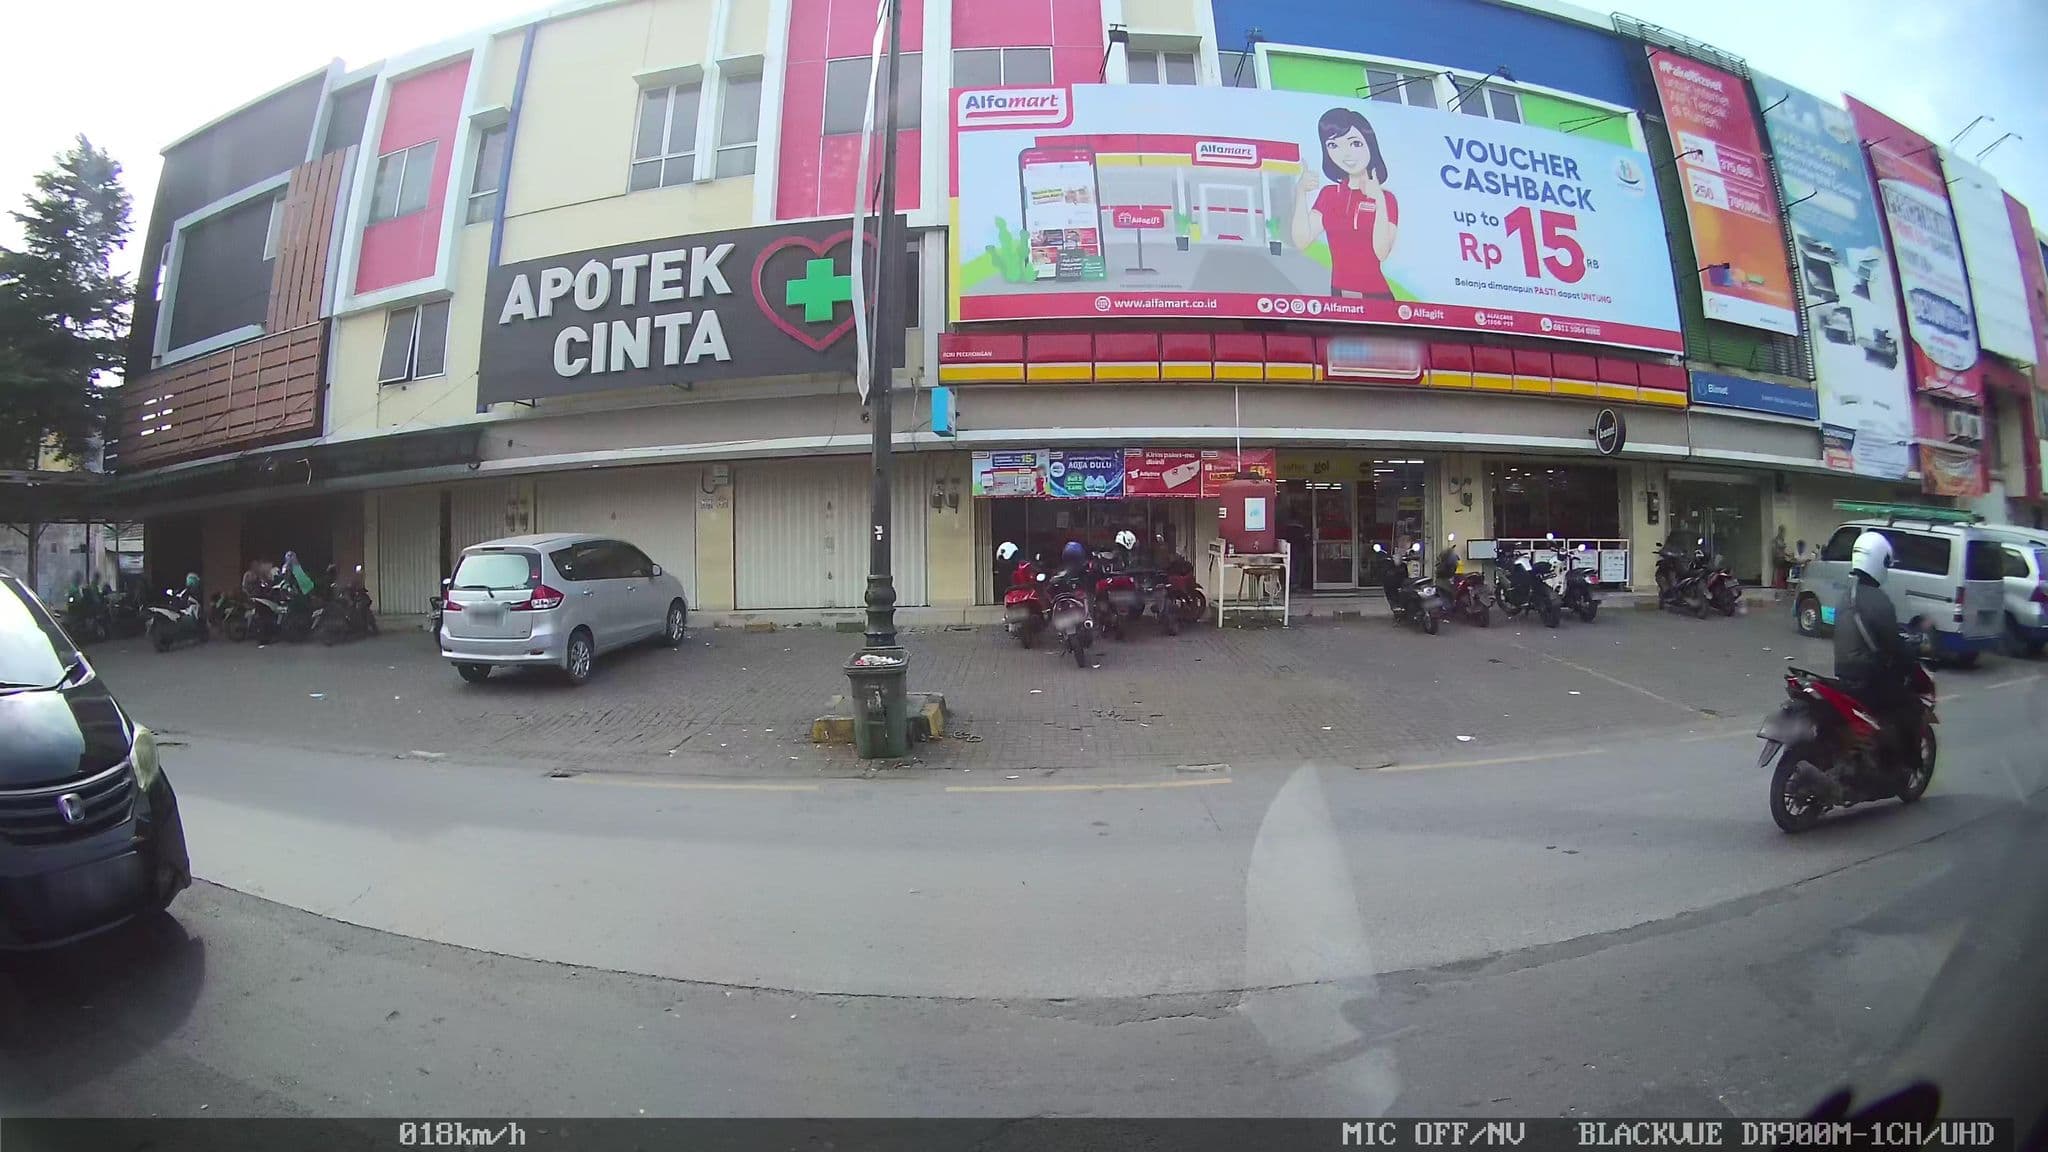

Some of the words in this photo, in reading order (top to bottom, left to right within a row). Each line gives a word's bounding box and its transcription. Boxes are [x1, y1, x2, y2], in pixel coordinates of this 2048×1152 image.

[965, 93, 1058, 110] Alfamart
[1200, 143, 1253, 157] Alfamart
[1444, 135, 1582, 181] VOUCHER
[1440, 164, 1597, 213] CASHBACK
[1454, 211, 1477, 226] up
[1481, 210, 1499, 227] to
[1459, 232, 1503, 270] Rp
[1503, 205, 1587, 284] 15
[1586, 258, 1600, 270] RB
[499, 243, 736, 325] APOTEK
[1455, 278, 1487, 289] Belanja
[1487, 281, 1534, 295] dimanapun
[1534, 286, 1556, 297] PASTI
[1557, 290, 1580, 301] dapat
[1581, 292, 1613, 304] UNTUNG
[1114, 298, 1218, 310] www.alfamart.co.id
[1323, 303, 1365, 314] Alfamart
[1413, 308, 1445, 320] Alfagift
[553, 309, 732, 378] CINTA
[1068, 461, 1088, 469] AQUA
[1089, 461, 1112, 469] DULU
